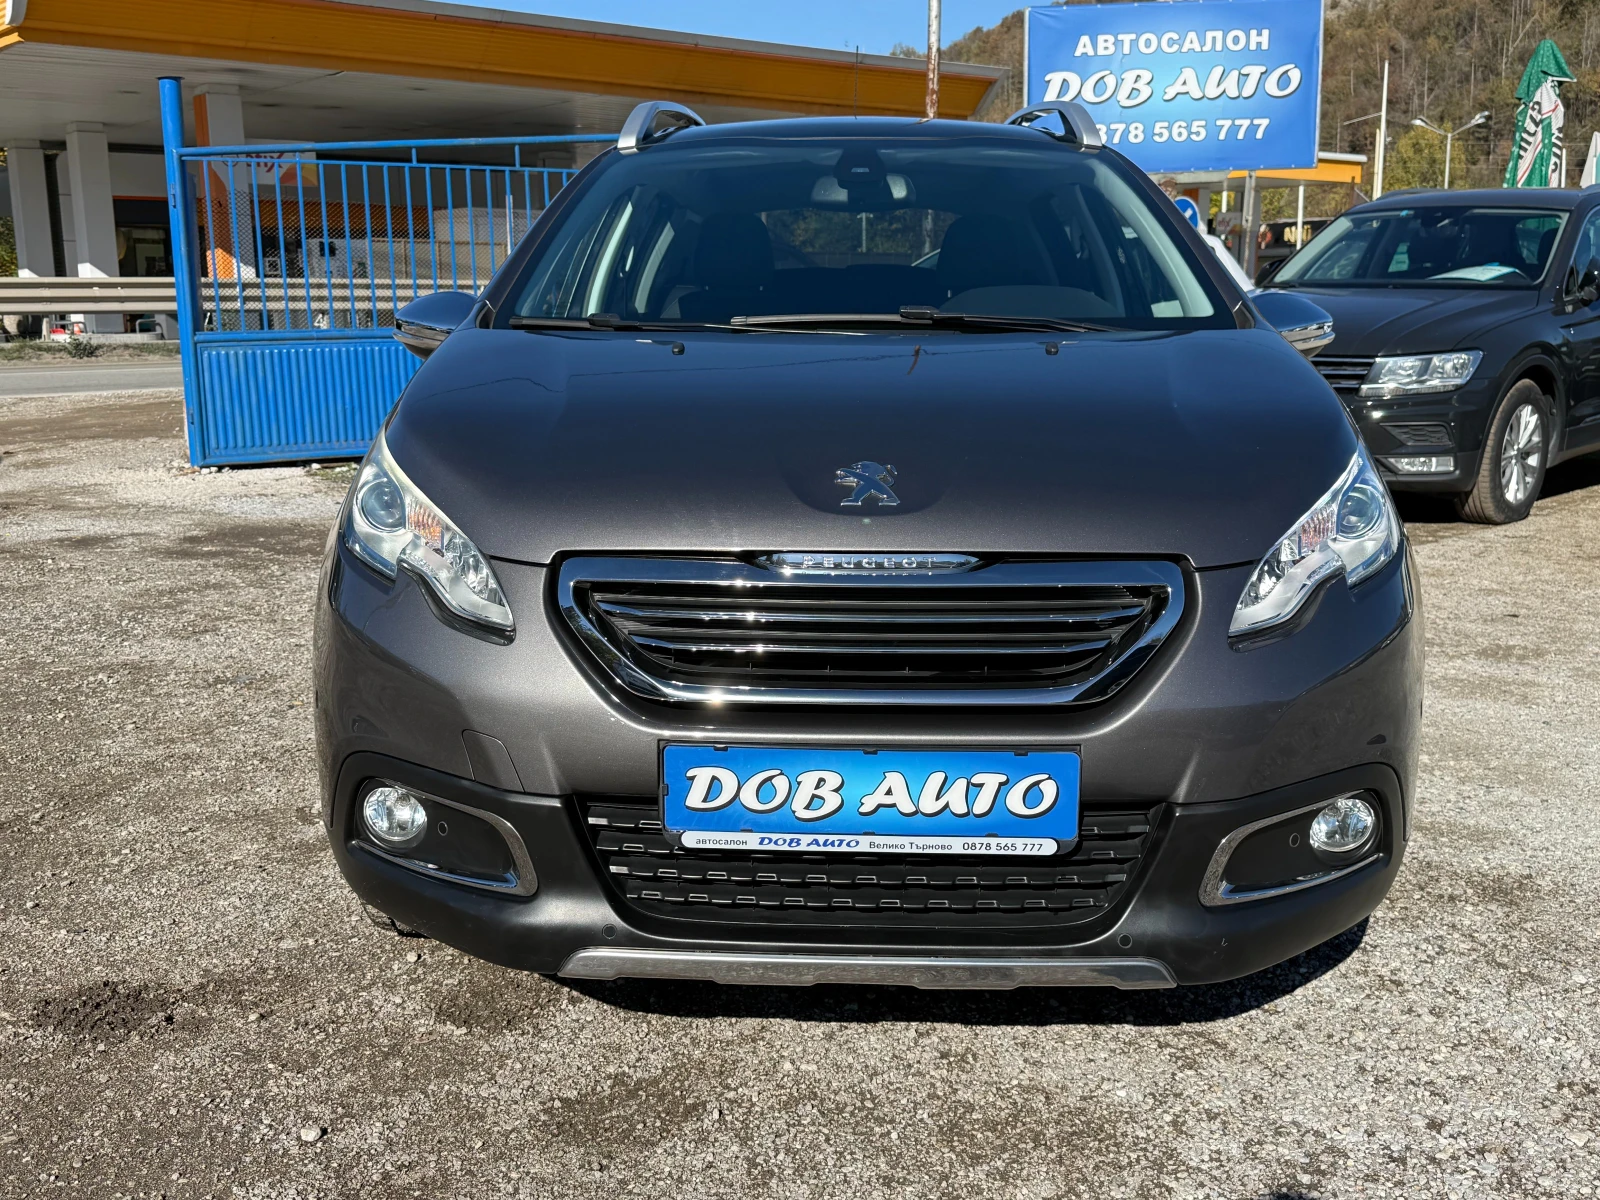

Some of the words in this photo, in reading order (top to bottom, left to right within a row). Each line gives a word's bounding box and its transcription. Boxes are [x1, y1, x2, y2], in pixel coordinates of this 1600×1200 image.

[1073, 28, 1270, 57] АВТОСАЛОН
[1043, 69, 1154, 108] DOB
[1162, 63, 1302, 101] AUTO
[1152, 120, 1207, 142] 565
[1215, 118, 1270, 141] 777
[801, 555, 938, 568] PEUGEOT
[685, 766, 846, 822] DOB
[858, 771, 1060, 818] AUTO
[695, 838, 748, 846] автосалон
[758, 836, 802, 848] DOB
[806, 838, 860, 848] AUTO
[869, 841, 906, 850] Велико
[908, 841, 953, 851] Търново
[962, 842, 992, 851] 0878
[995, 842, 1017, 851] 565
[1021, 843, 1044, 852] 777
